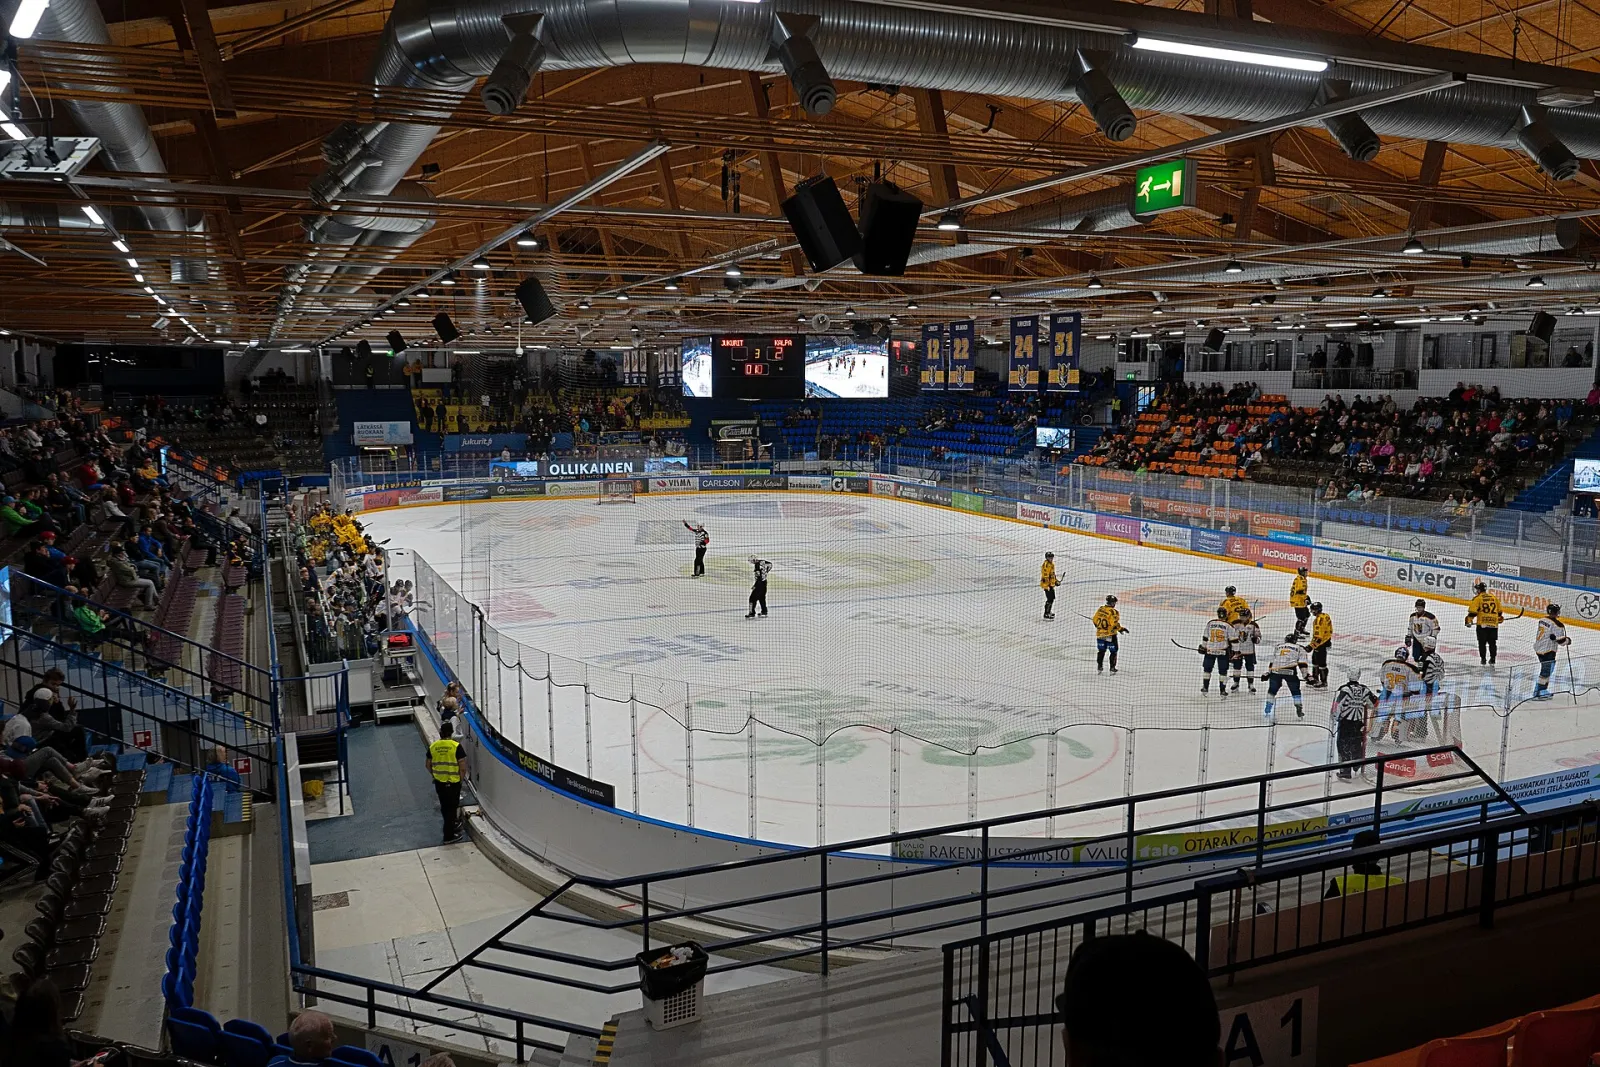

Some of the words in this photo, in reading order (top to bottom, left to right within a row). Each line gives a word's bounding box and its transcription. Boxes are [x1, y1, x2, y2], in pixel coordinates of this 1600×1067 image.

[720, 339, 744, 347] JUKURIT
[774, 339, 793, 347] KALPA
[927, 338, 940, 360] 12
[953, 338, 969, 360] 22
[1014, 334, 1034, 359] 24
[1054, 331, 1073, 357] 31
[754, 348, 760, 359] 3
[775, 347, 783, 359] 2
[549, 462, 633, 475] OLLIKAINEN
[668, 479, 692, 487] VISMA
[702, 479, 740, 488] CARLSON
[832, 478, 852, 492] GL
[1104, 521, 1131, 534] MIKKELI
[1261, 516, 1296, 528] GATORADE
[1262, 548, 1308, 564] McDonald's
[1328, 558, 1361, 572] Suur-Savo
[1397, 564, 1457, 590] elvera
[1489, 579, 1519, 592] MIKKELI
[1481, 602, 1497, 615] 82
[1430, 752, 1452, 762] Scan
[518, 751, 556, 781] CASEMET
[1384, 761, 1412, 774] candic
[1556, 770, 1590, 783] TILAUSAJOT
[1139, 843, 1179, 858] talo
